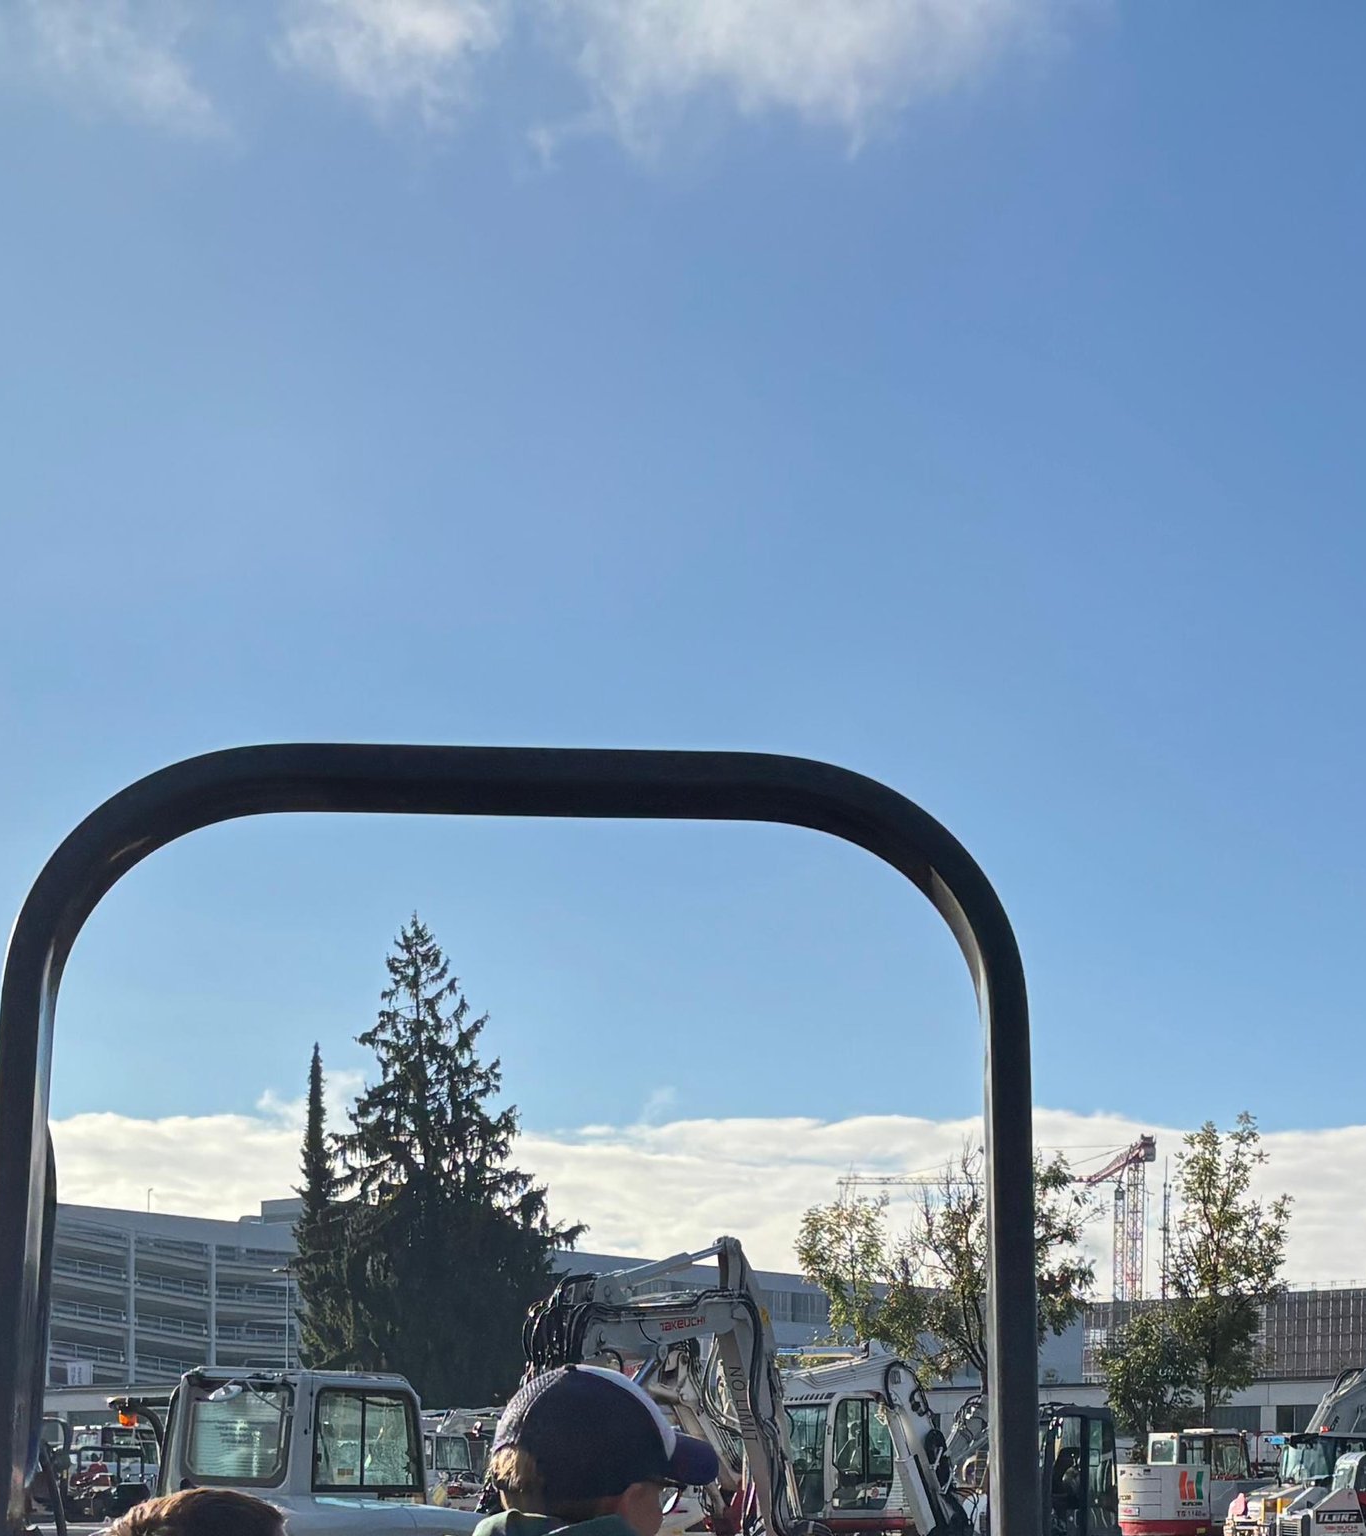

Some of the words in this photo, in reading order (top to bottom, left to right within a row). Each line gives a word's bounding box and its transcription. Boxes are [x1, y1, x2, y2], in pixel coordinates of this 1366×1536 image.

[660, 1316, 706, 1332] TAKEUCHI
[729, 1366, 747, 1391] NO
[736, 1399, 758, 1441] LIMIT
